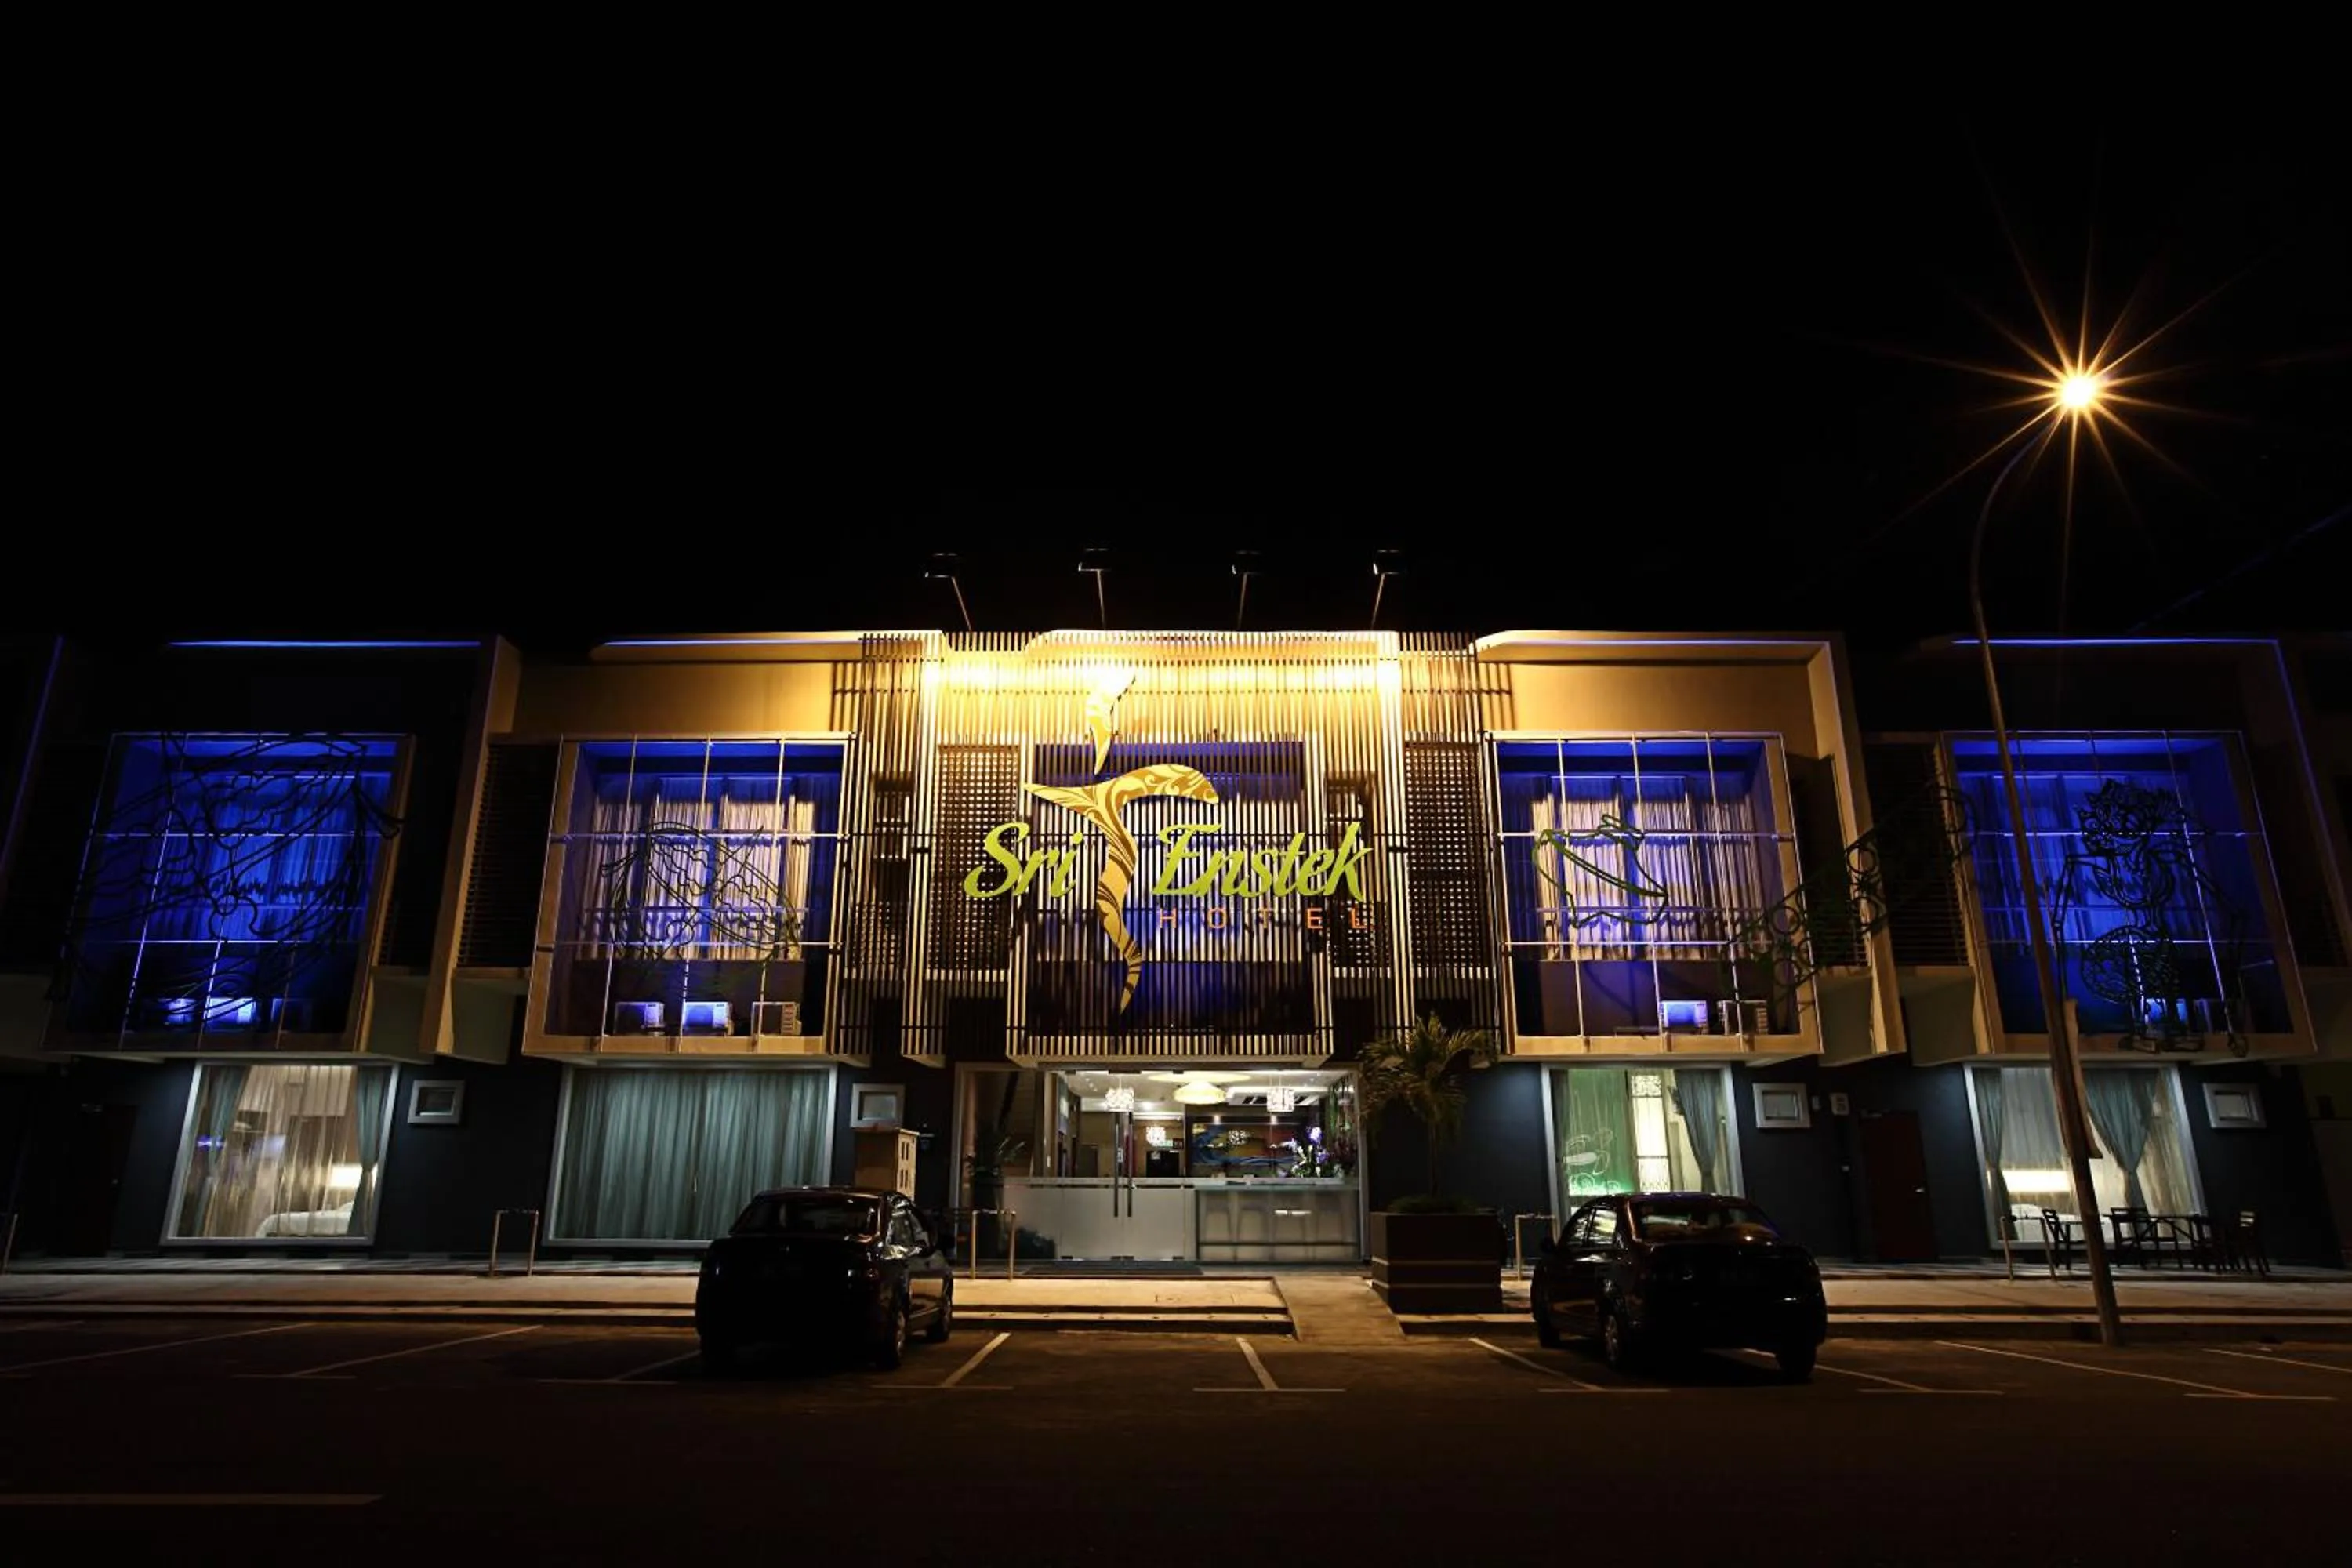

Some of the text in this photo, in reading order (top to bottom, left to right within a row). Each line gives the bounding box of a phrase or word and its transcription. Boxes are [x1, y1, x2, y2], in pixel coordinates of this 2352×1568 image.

[964, 822, 1373, 902] Sri Enstek
[1160, 908, 1369, 930] HOTEL
